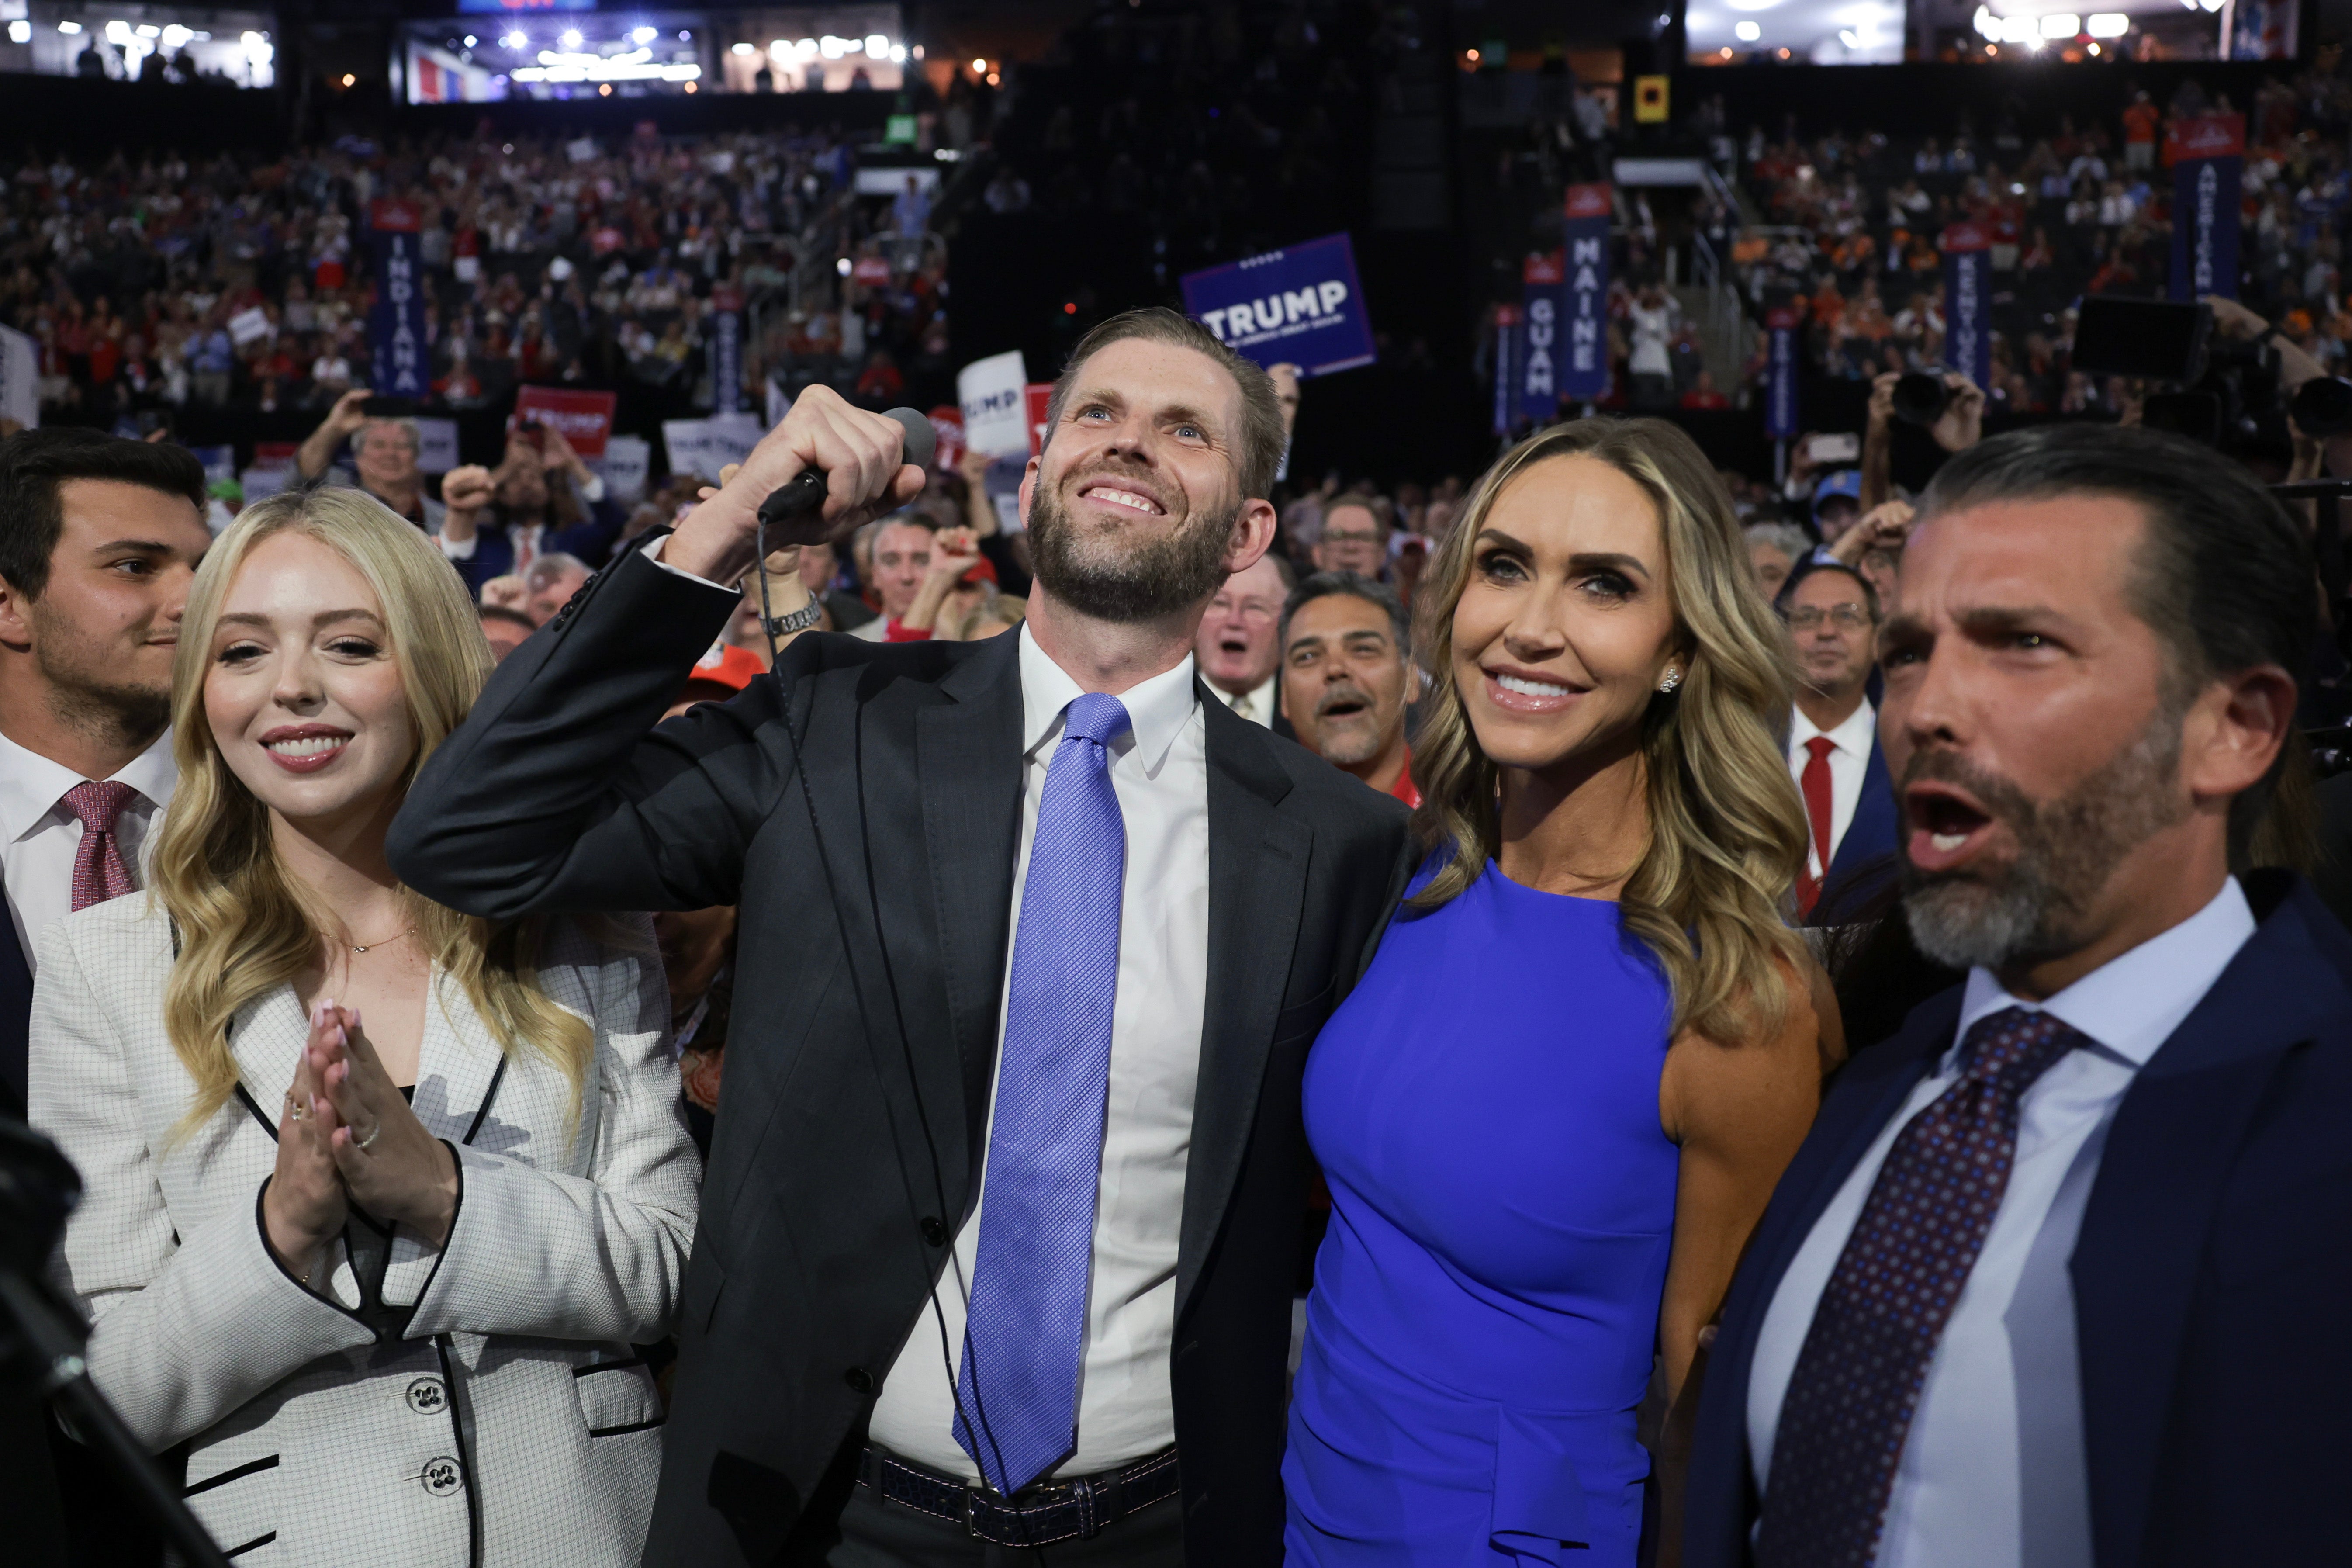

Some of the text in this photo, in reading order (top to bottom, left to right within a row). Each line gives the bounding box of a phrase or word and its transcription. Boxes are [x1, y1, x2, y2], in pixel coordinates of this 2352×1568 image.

[387, 234, 418, 391] INDIANA
[1201, 280, 1349, 340] TRUMP
[1525, 297, 1555, 396] GUAM
[1573, 236, 1601, 372] MAINE
